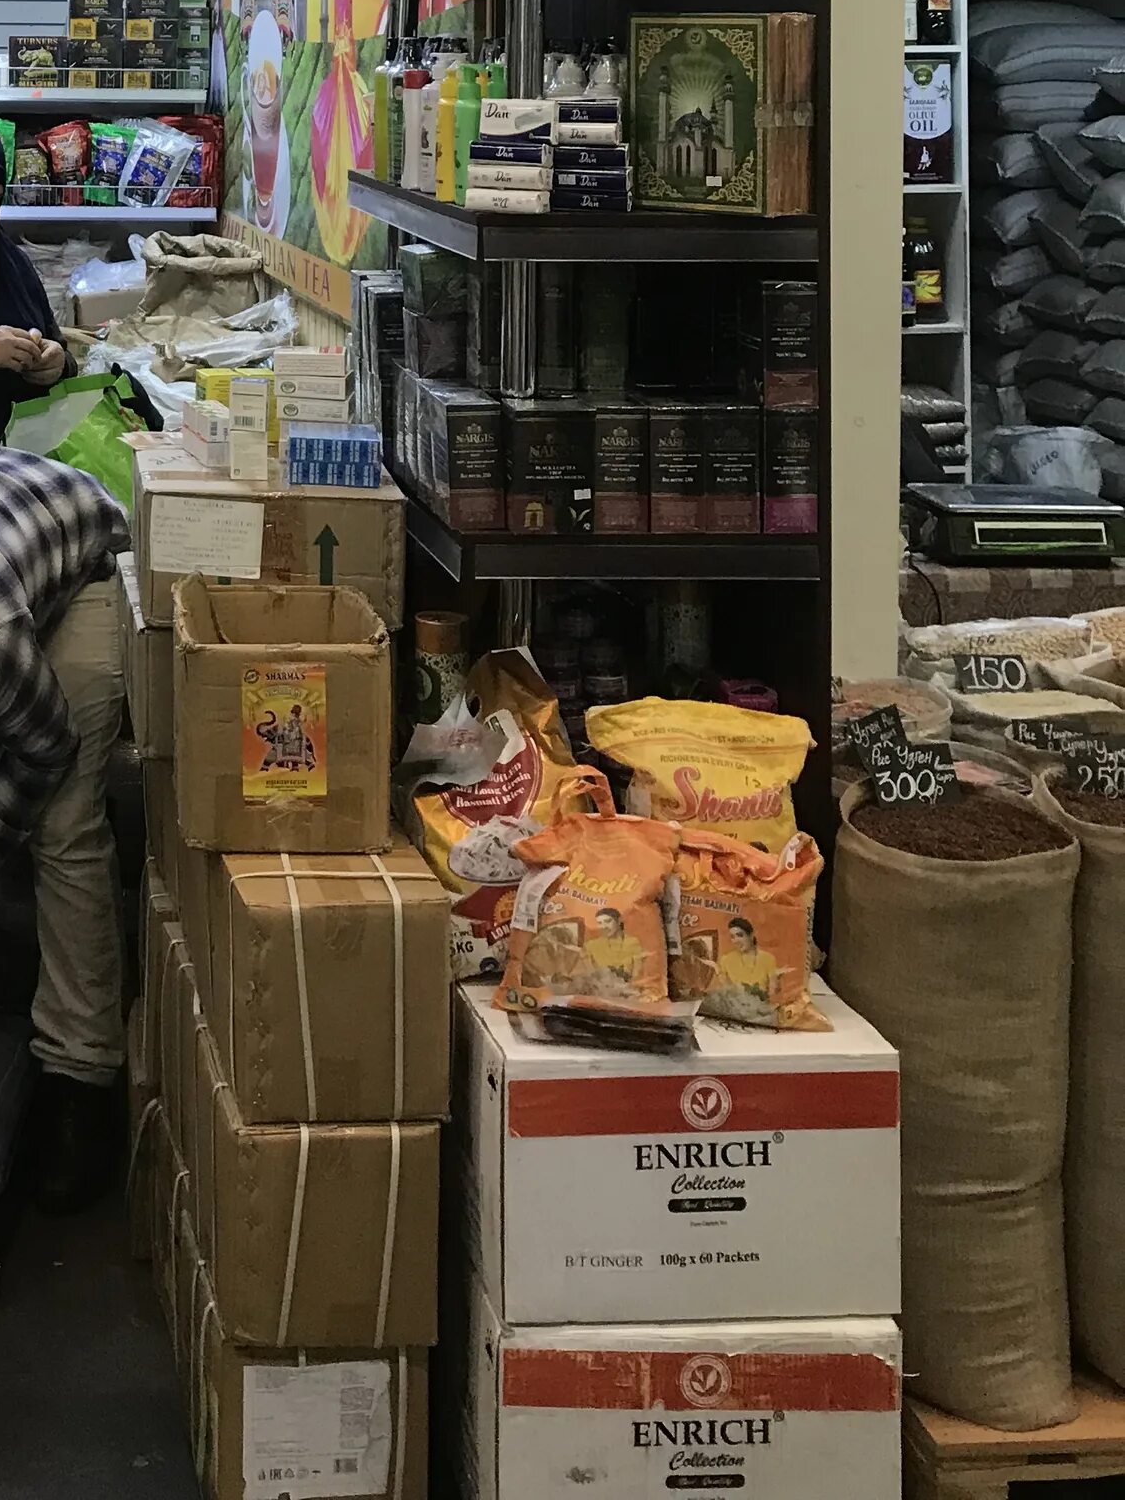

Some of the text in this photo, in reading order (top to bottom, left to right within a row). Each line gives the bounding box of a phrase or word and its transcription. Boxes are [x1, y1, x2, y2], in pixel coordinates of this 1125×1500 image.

[17, 37, 59, 45] TURNERS
[485, 102, 511, 119] Dan
[570, 109, 589, 121] Dan
[908, 111, 936, 120] OLIVE
[569, 128, 588, 140] Dan
[909, 119, 938, 132] OIL
[495, 146, 514, 158] Dan
[579, 151, 597, 164] Dan
[494, 170, 512, 182] Dan
[579, 174, 598, 187] Dan
[580, 194, 600, 208] Dan
[303, 258, 331, 302] TEA
[455, 433, 495, 444] NARGIS
[601, 436, 639, 447] NARGIS
[962, 657, 1026, 690] 150
[660, 754, 758, 773] RICHNESS IN EVERY GRAIN
[871, 746, 891, 766] Рис
[475, 783, 502, 795] Long
[502, 772, 531, 792] Grain
[456, 787, 525, 808] Basmati Rice
[659, 766, 784, 823] Shanti
[572, 888, 609, 906] BASMATI
[704, 899, 741, 915] BASMATI
[633, 1140, 773, 1171] ENRICH
[670, 1173, 746, 1194] Collection
[590, 1254, 644, 1268] GINGER
[659, 1253, 687, 1268] 100g
[689, 1255, 697, 1264] x
[698, 1252, 714, 1264] 60
[715, 1250, 761, 1264] Packets
[632, 1418, 772, 1448] ENRICH
[668, 1450, 745, 1471] Collection
